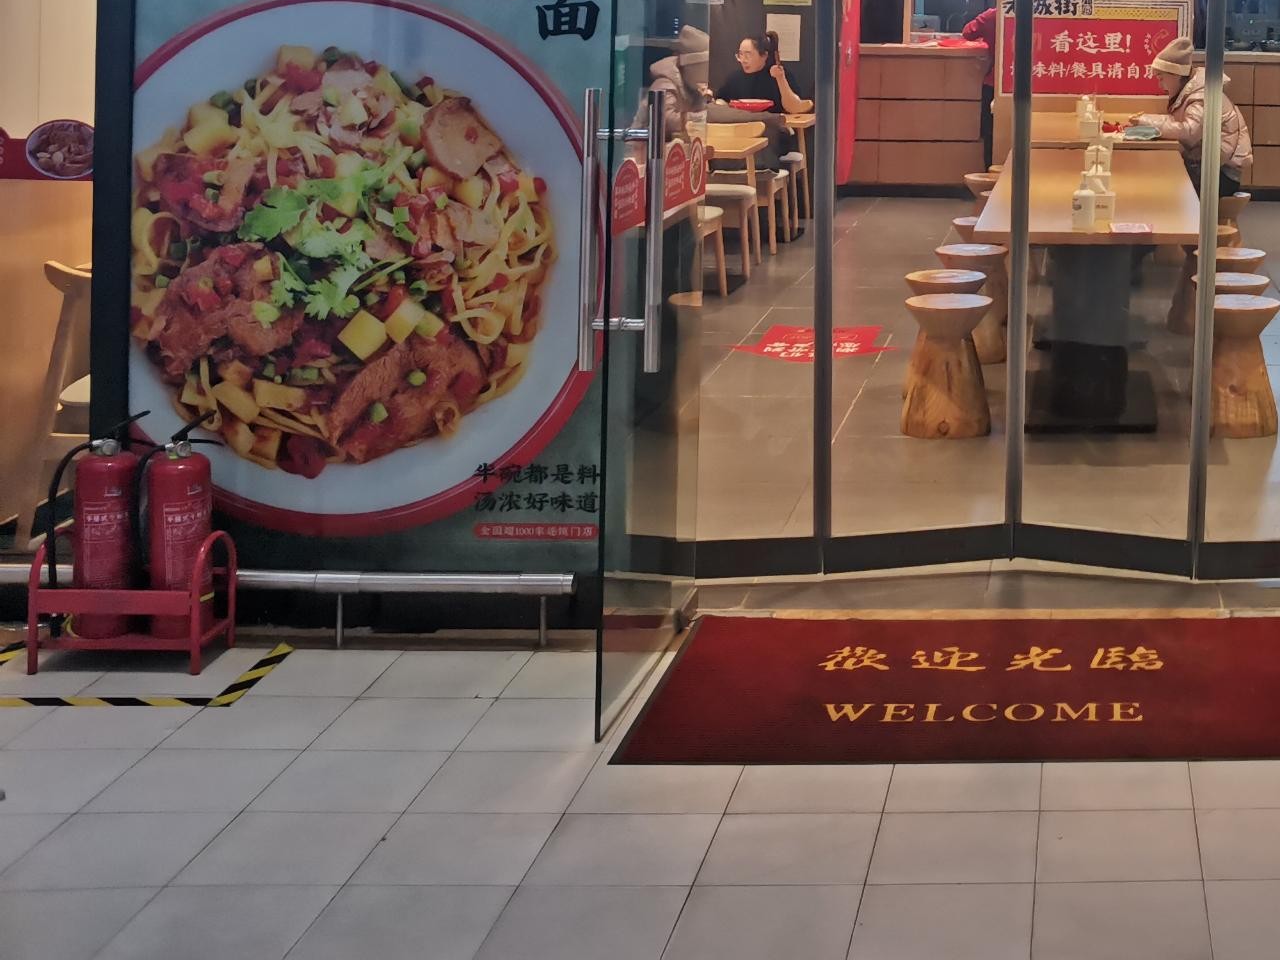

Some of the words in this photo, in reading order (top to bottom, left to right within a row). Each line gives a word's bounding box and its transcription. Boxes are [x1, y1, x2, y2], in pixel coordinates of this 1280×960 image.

[1050, 29, 1132, 54] 看这里！
[474, 491, 600, 514] 汤浓好味道
[825, 701, 1145, 724] WELCOME
